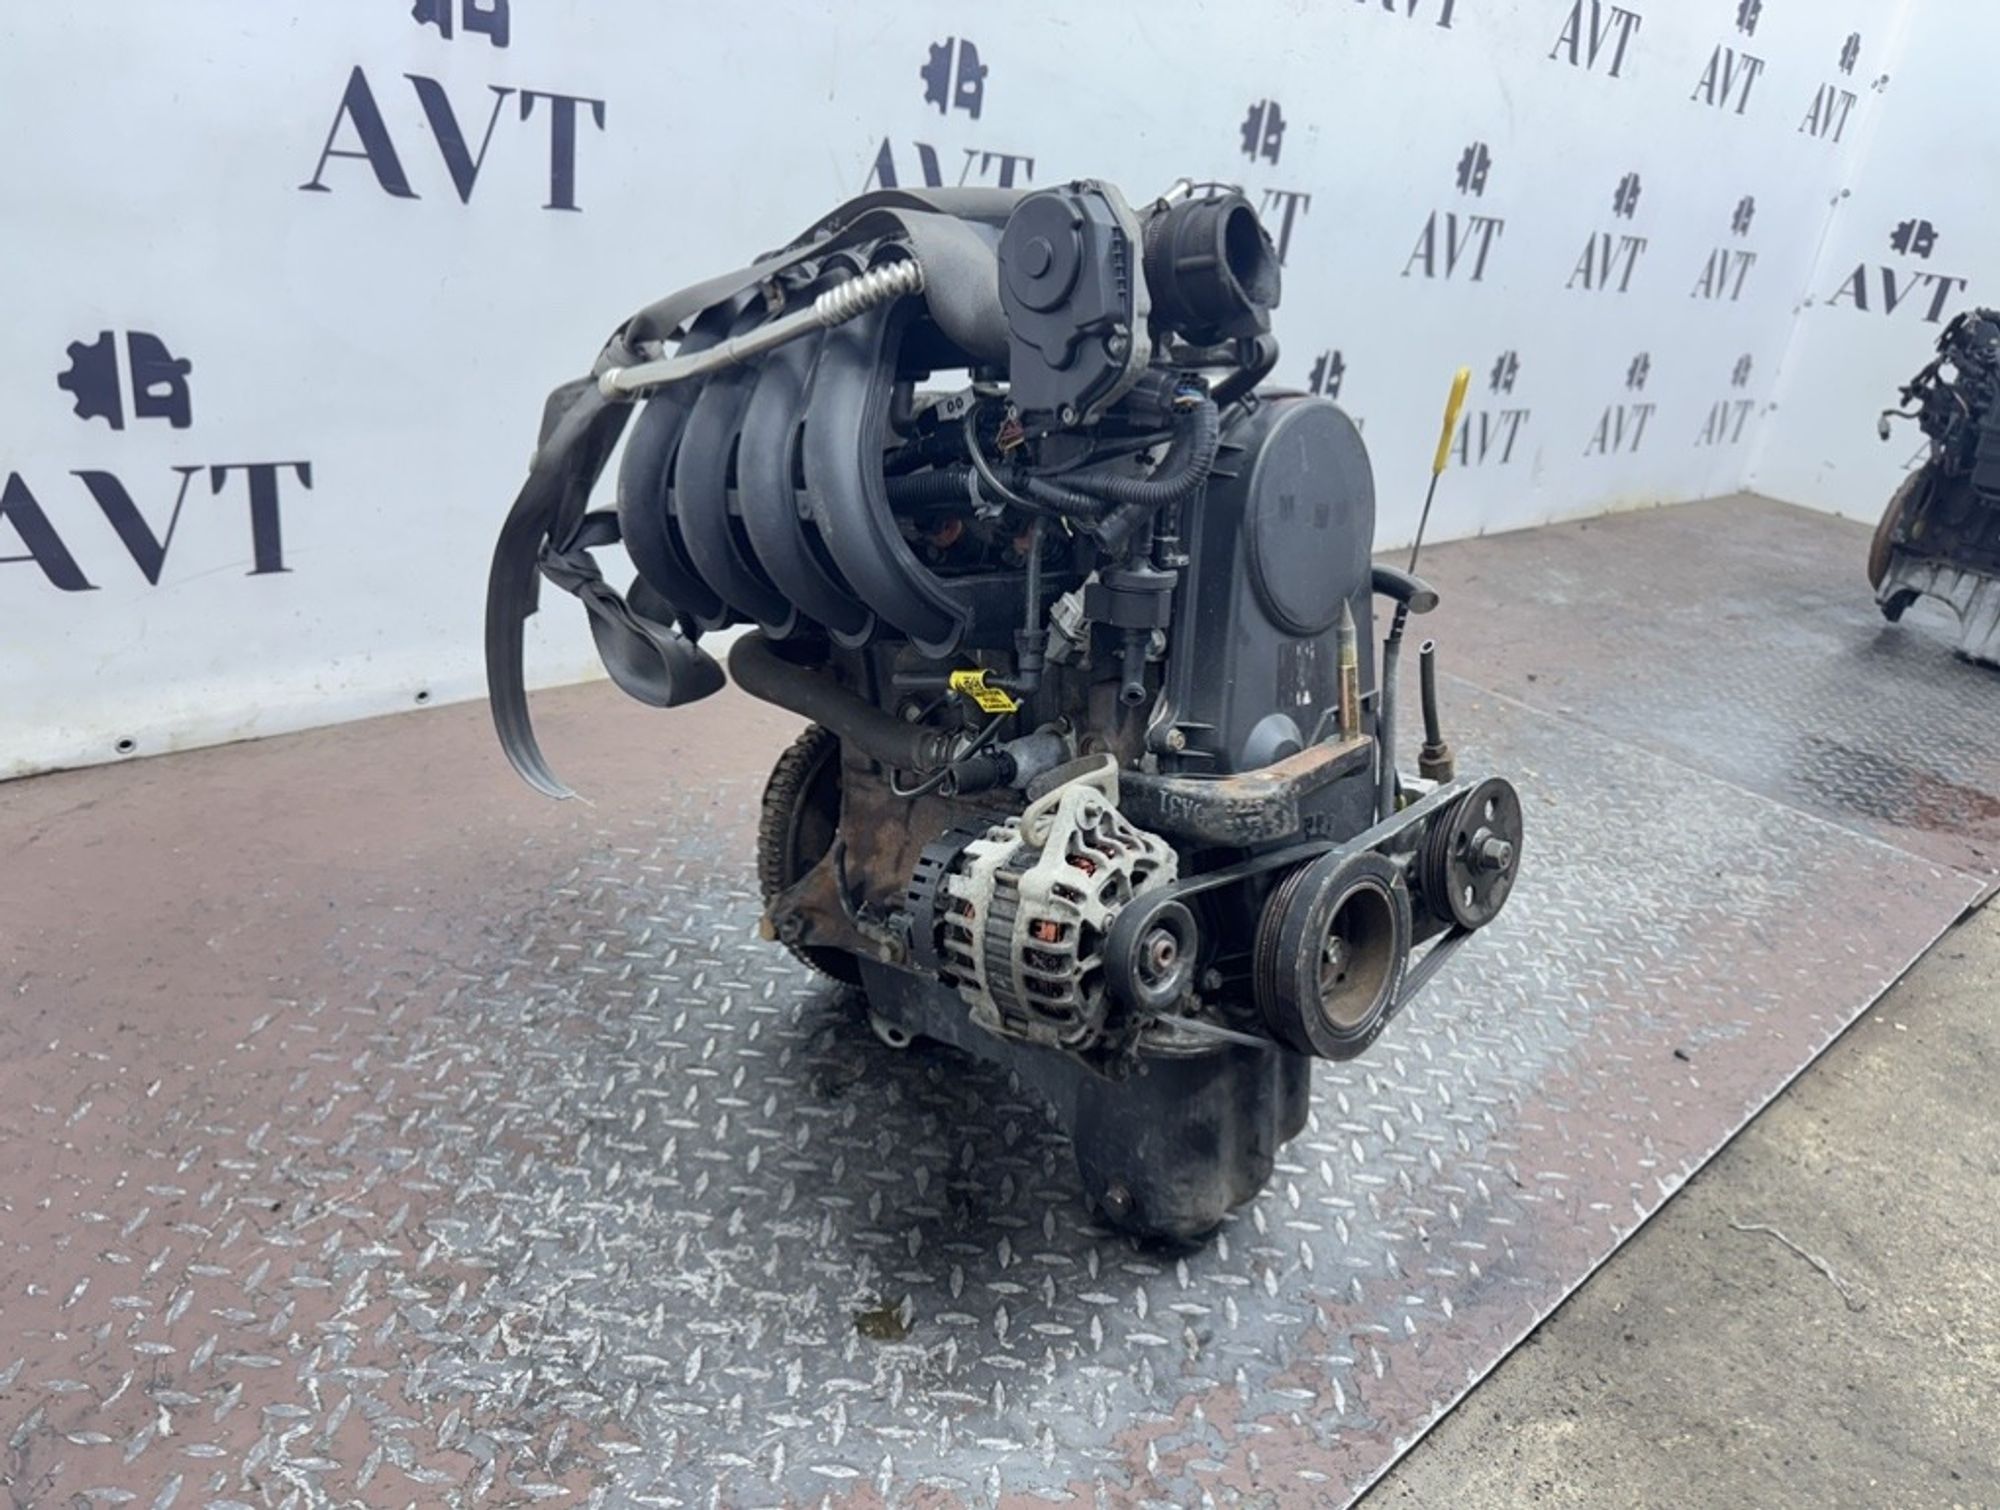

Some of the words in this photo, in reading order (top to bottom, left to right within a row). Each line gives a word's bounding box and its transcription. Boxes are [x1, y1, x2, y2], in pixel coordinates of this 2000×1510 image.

[1548, 0, 1642, 78] AVT
[1690, 43, 1765, 115] AVT
[297, 65, 606, 212] AVT
[1797, 82, 1858, 143] AVT
[1401, 208, 1505, 282] AVT
[1565, 230, 1648, 293] AVT
[1690, 247, 1757, 301] AVT
[1824, 262, 1968, 324] AVT
[1449, 410, 1530, 466] AVT
[1583, 404, 1656, 456] AVT
[1694, 400, 1755, 447] AVT
[0, 461, 313, 591] AVT
